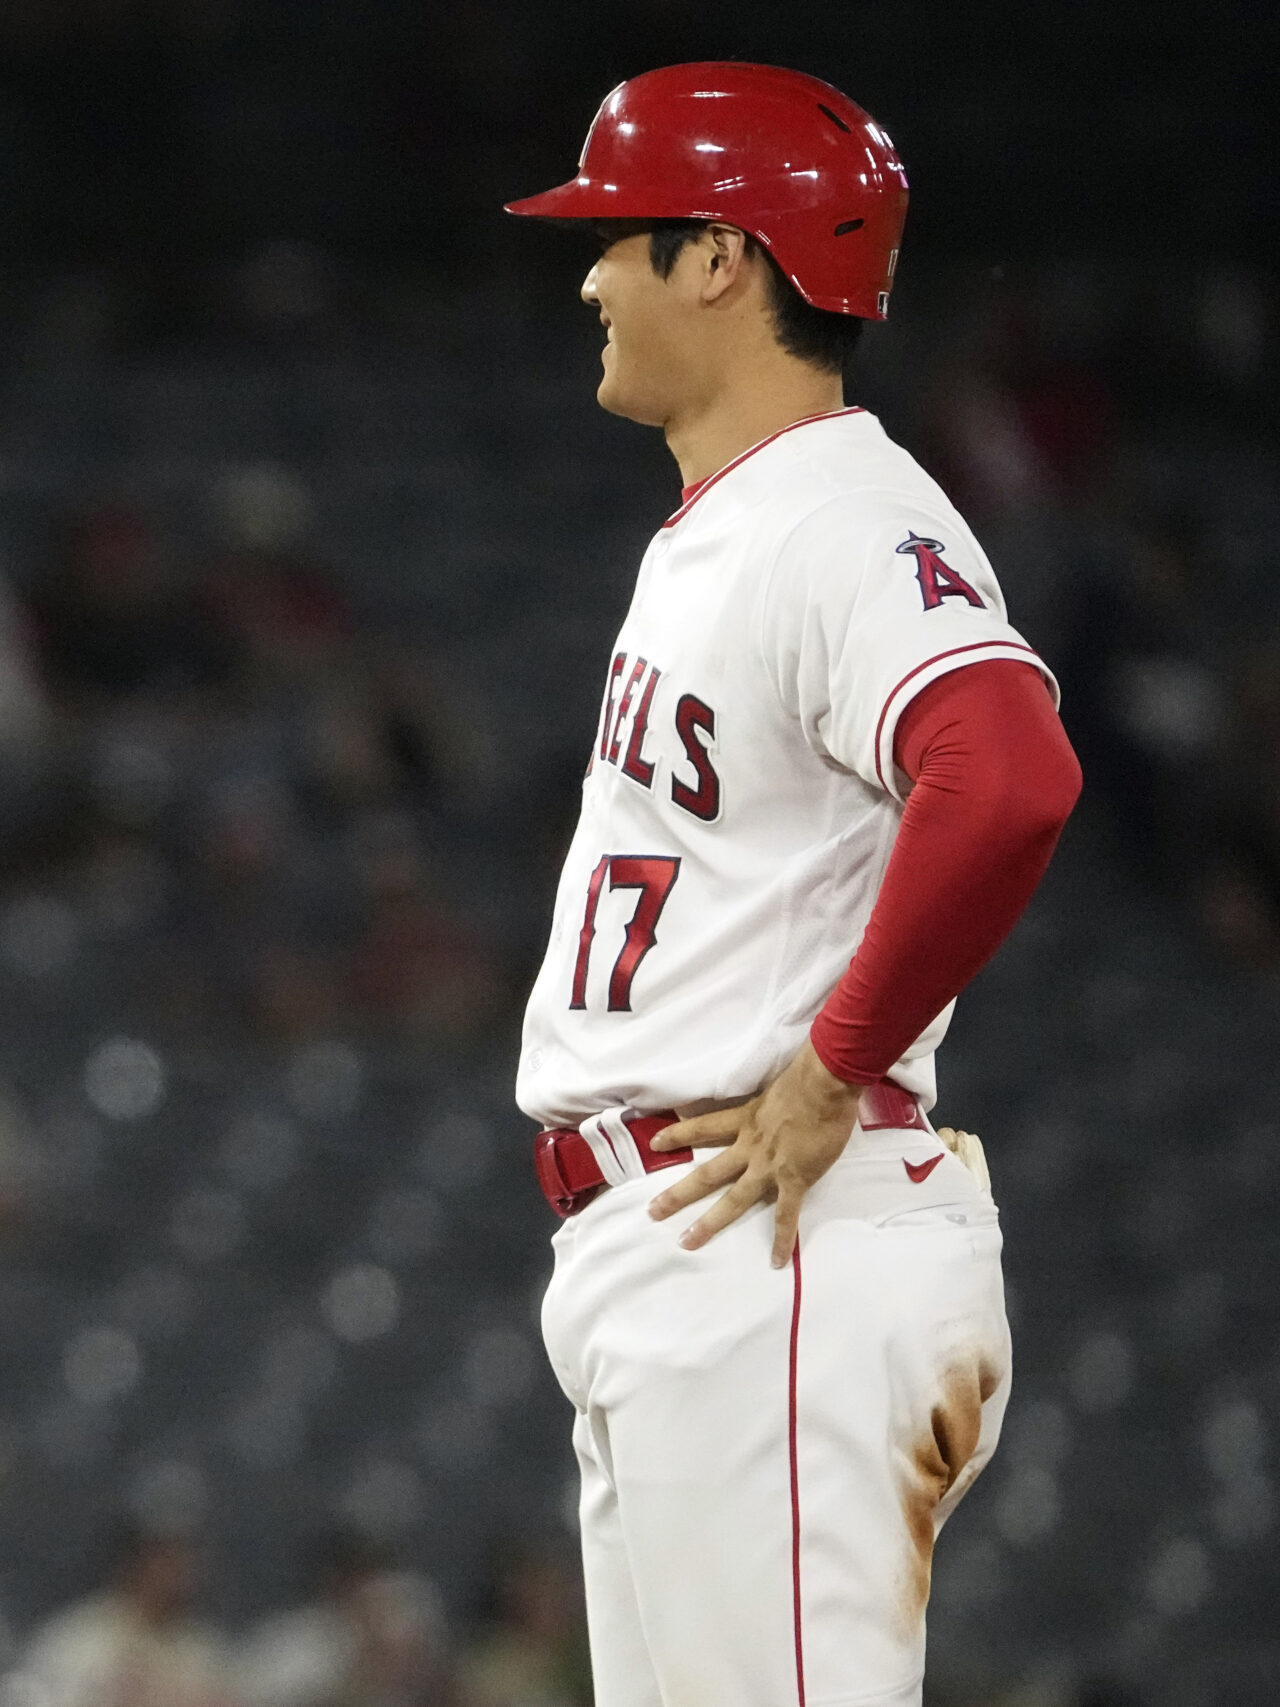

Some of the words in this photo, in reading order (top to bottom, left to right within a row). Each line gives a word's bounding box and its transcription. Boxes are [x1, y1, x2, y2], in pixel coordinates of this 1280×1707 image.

[895, 529, 988, 612] A
[584, 650, 722, 823] GELS
[567, 853, 683, 1014] 17
